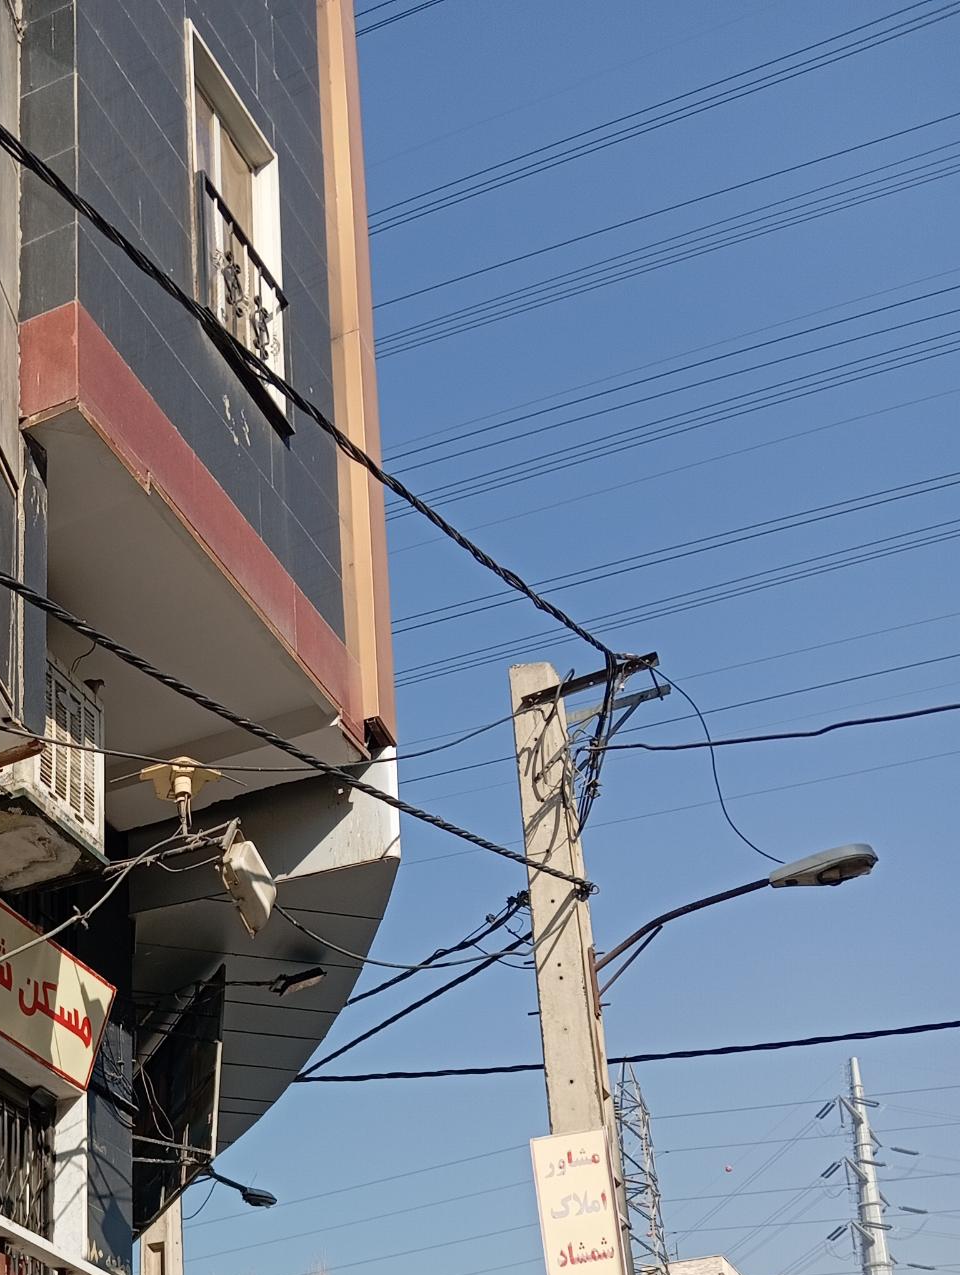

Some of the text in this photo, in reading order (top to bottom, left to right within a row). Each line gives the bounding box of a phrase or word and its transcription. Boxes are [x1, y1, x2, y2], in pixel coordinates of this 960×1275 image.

[18, 977, 92, 1049] مسکن
[544, 1148, 601, 1179] مشاور
[550, 1188, 608, 1220] املاک
[557, 1236, 615, 1268] شمشاد
